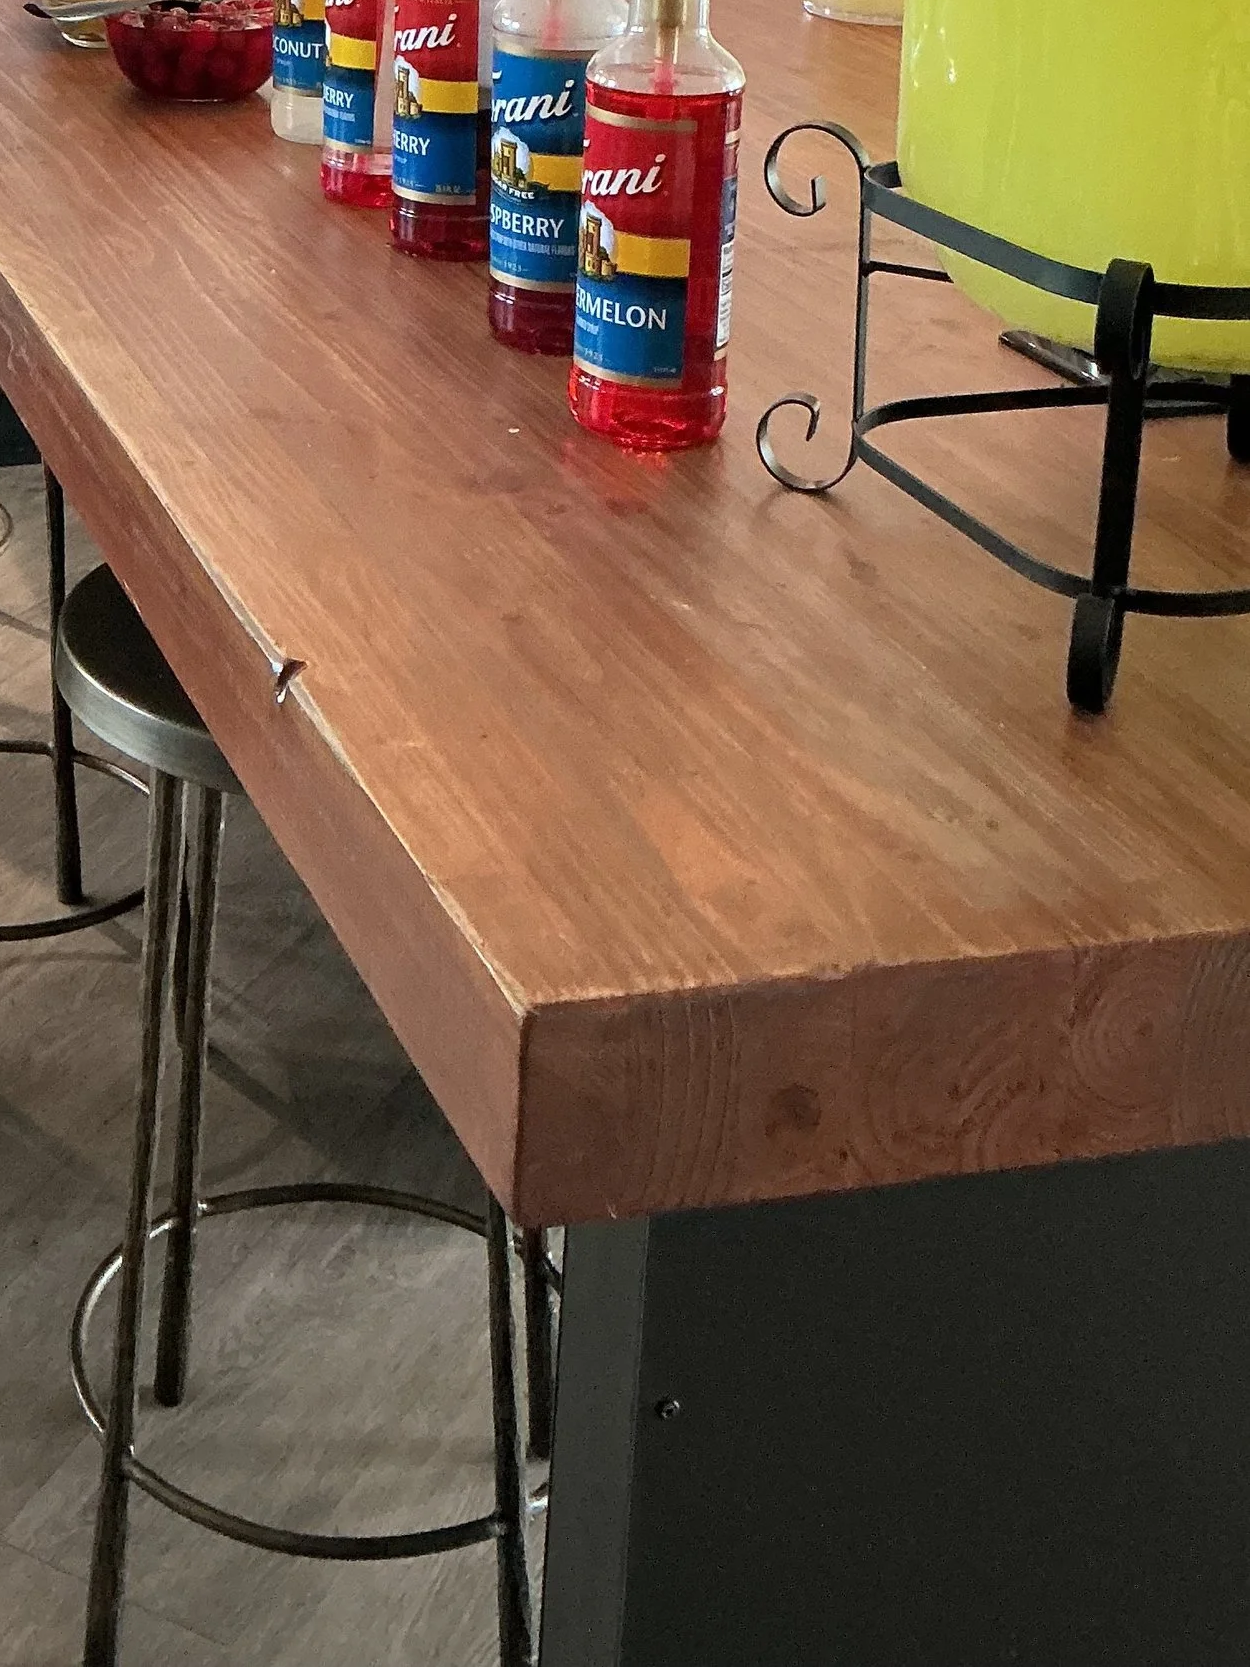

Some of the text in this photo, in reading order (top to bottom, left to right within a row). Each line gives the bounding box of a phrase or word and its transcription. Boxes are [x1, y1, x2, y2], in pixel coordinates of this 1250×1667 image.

[394, 5, 458, 53] rani
[491, 70, 575, 124] rani
[508, 187, 535, 200] FREE
[581, 139, 667, 197] rani
